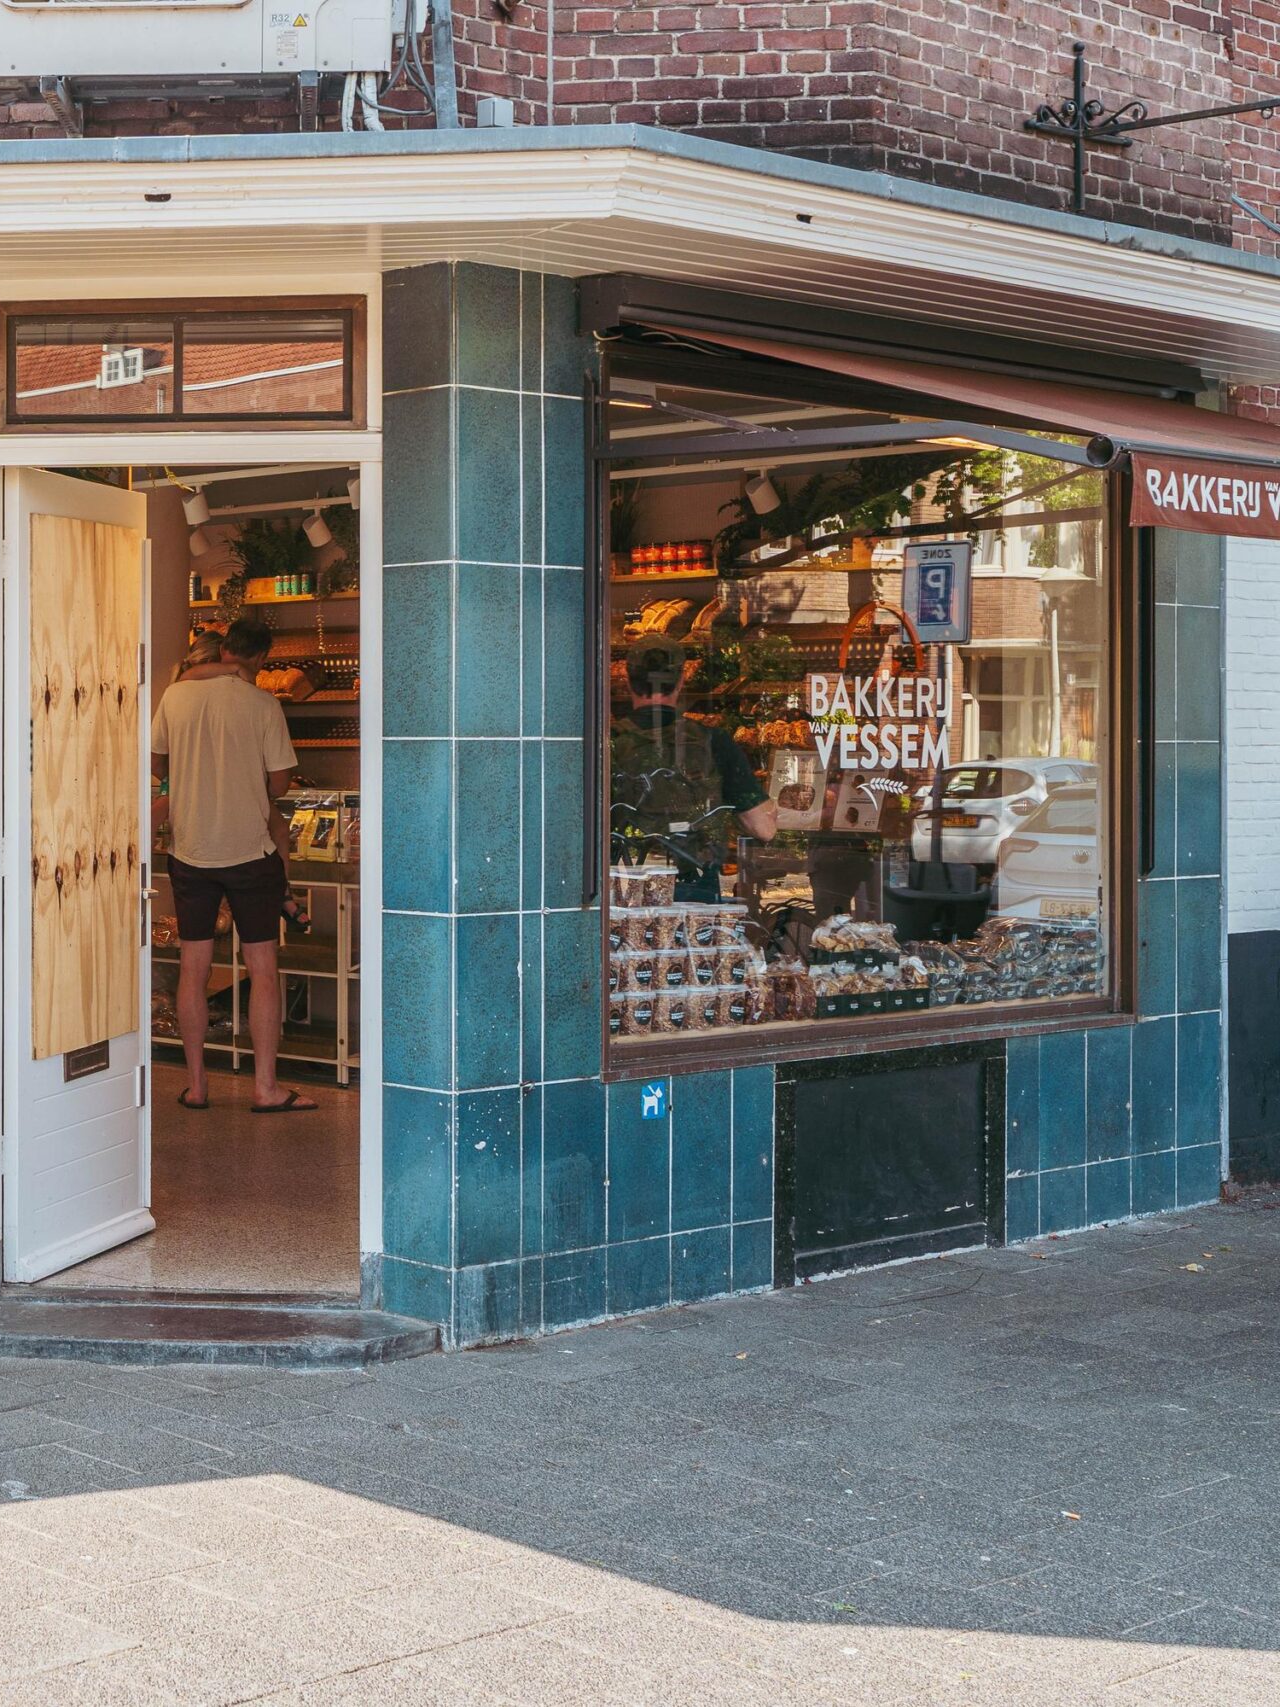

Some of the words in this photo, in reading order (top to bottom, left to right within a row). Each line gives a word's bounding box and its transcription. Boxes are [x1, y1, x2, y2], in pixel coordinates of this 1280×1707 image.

[1146, 468, 1261, 518] BAKKERIJ
[811, 675, 950, 718] BAKKERIJ
[808, 721, 829, 734] VAN
[815, 723, 950, 769] VESSEM
